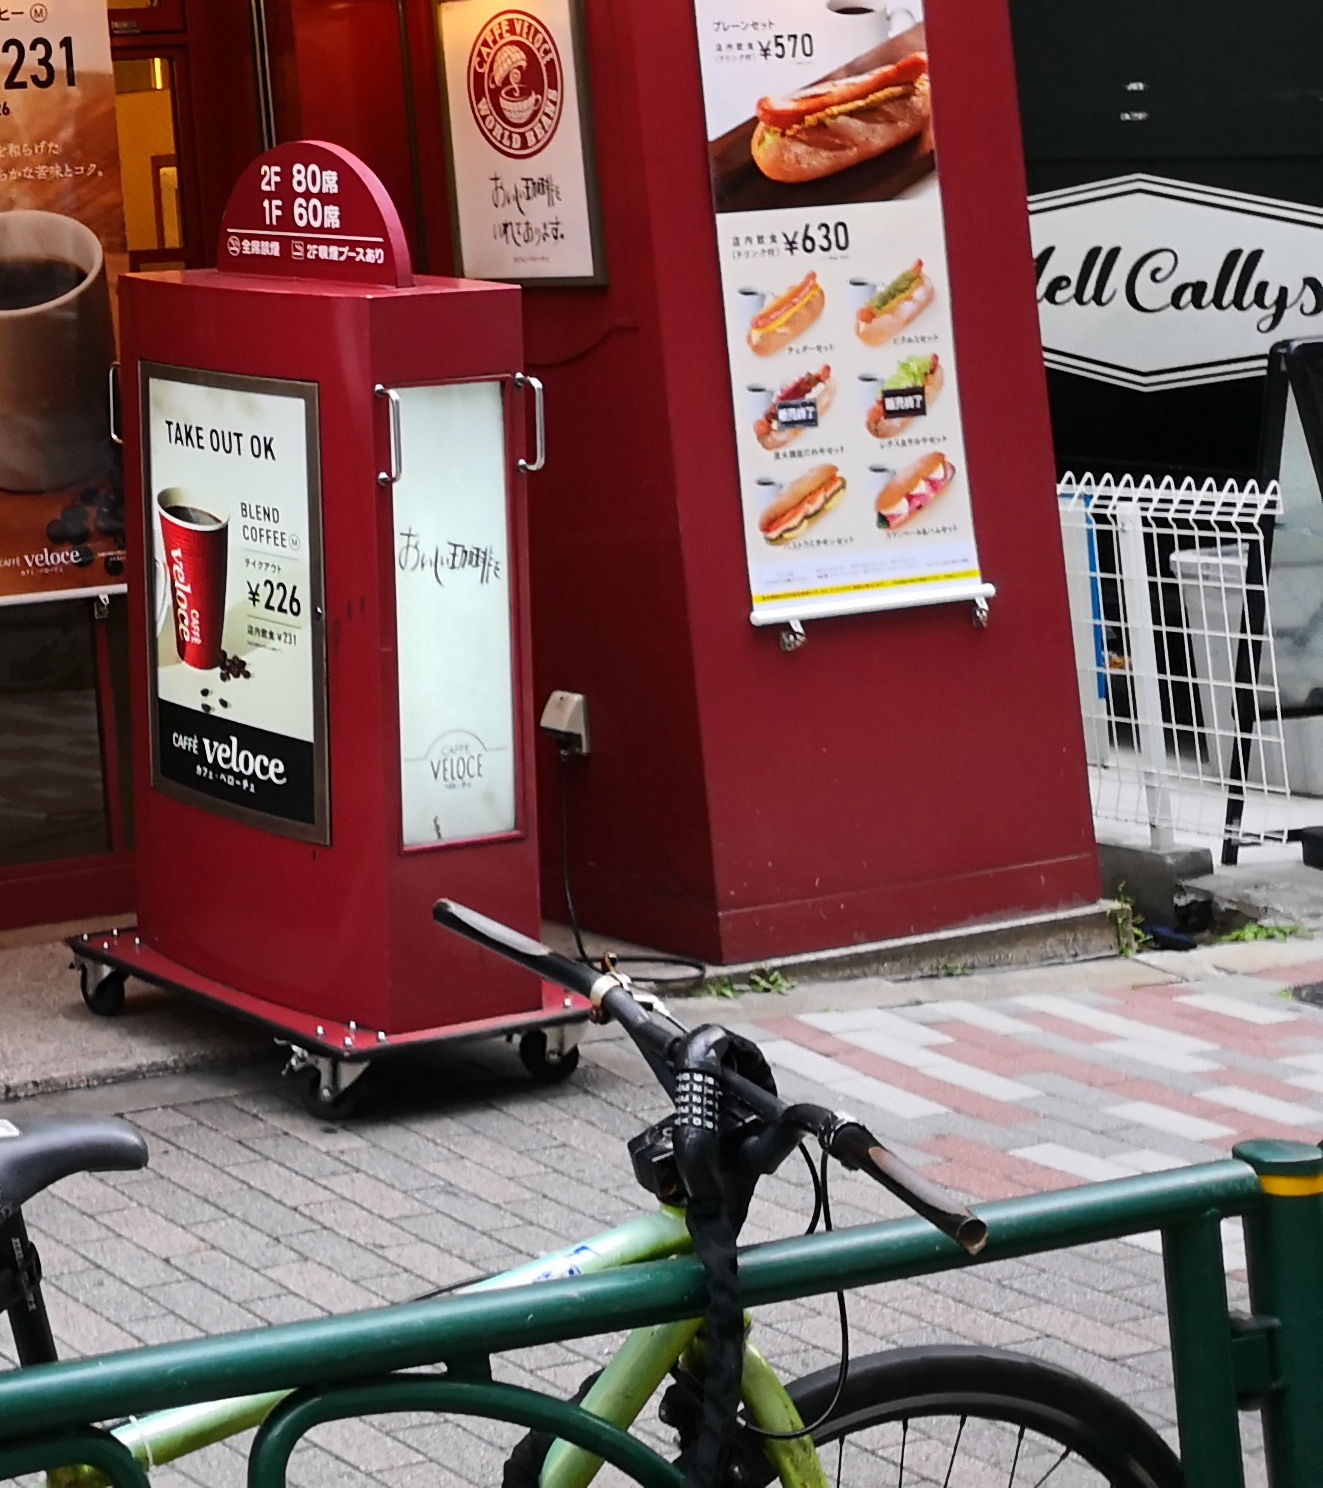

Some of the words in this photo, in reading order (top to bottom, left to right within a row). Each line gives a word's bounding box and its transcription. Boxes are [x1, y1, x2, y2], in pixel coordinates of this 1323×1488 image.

[474, 18, 512, 74] CAFFE
[514, 18, 556, 64] VELOCE
[757, 32, 814, 61] ¥570
[476, 95, 522, 150] WORLD
[260, 164, 282, 192] 2F
[292, 163, 339, 194] 80席
[262, 199, 283, 226] 1F
[293, 197, 341, 229] 60席
[781, 221, 849, 256] ¥630
[165, 420, 205, 450] TAKE
[209, 428, 243, 456] OUT
[250, 434, 277, 462] OK
[240, 502, 280, 524] BLEND
[242, 524, 288, 549] COFFEE
[24, 547, 82, 568] veloce
[171, 547, 192, 643] veloce
[247, 578, 302, 617] ¥226
[202, 734, 288, 785] veloce
[430, 753, 483, 782] VELOCE
